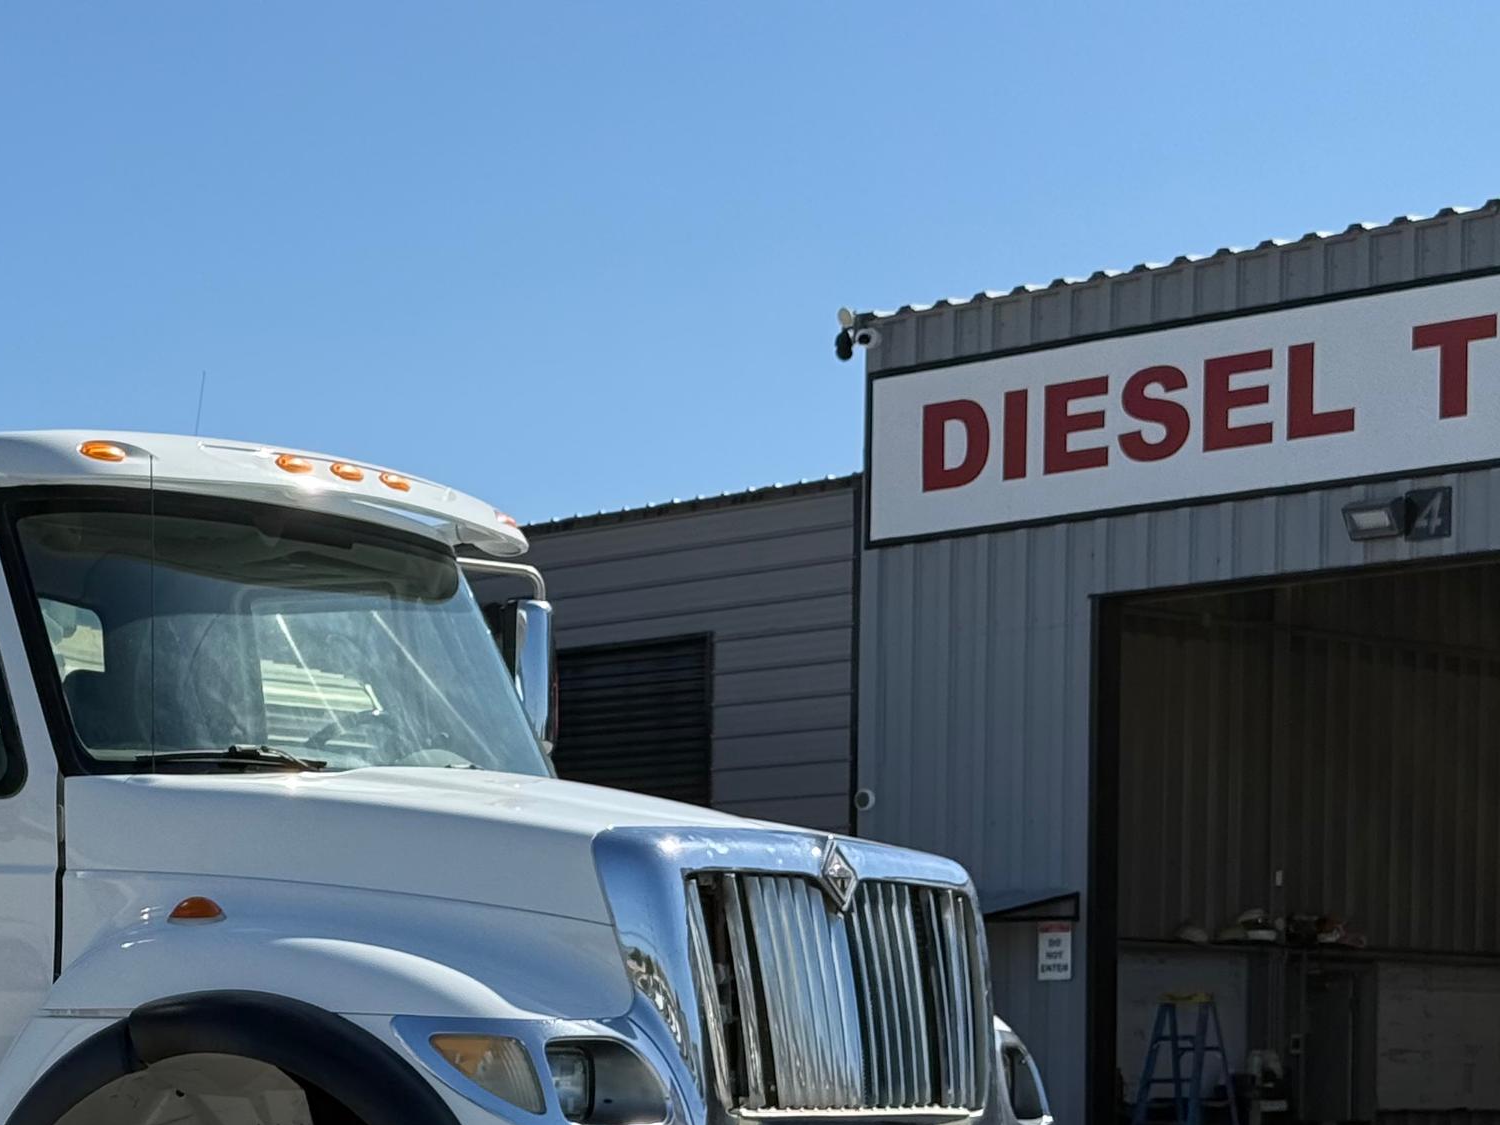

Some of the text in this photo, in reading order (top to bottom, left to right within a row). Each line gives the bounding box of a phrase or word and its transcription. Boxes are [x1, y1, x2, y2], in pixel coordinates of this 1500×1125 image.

[921, 313, 1497, 492] DIESEL T
[1414, 491, 1443, 535] 4
[1048, 938, 1062, 948] DO
[1045, 951, 1063, 960] NOT
[1040, 963, 1069, 973] ENTER
